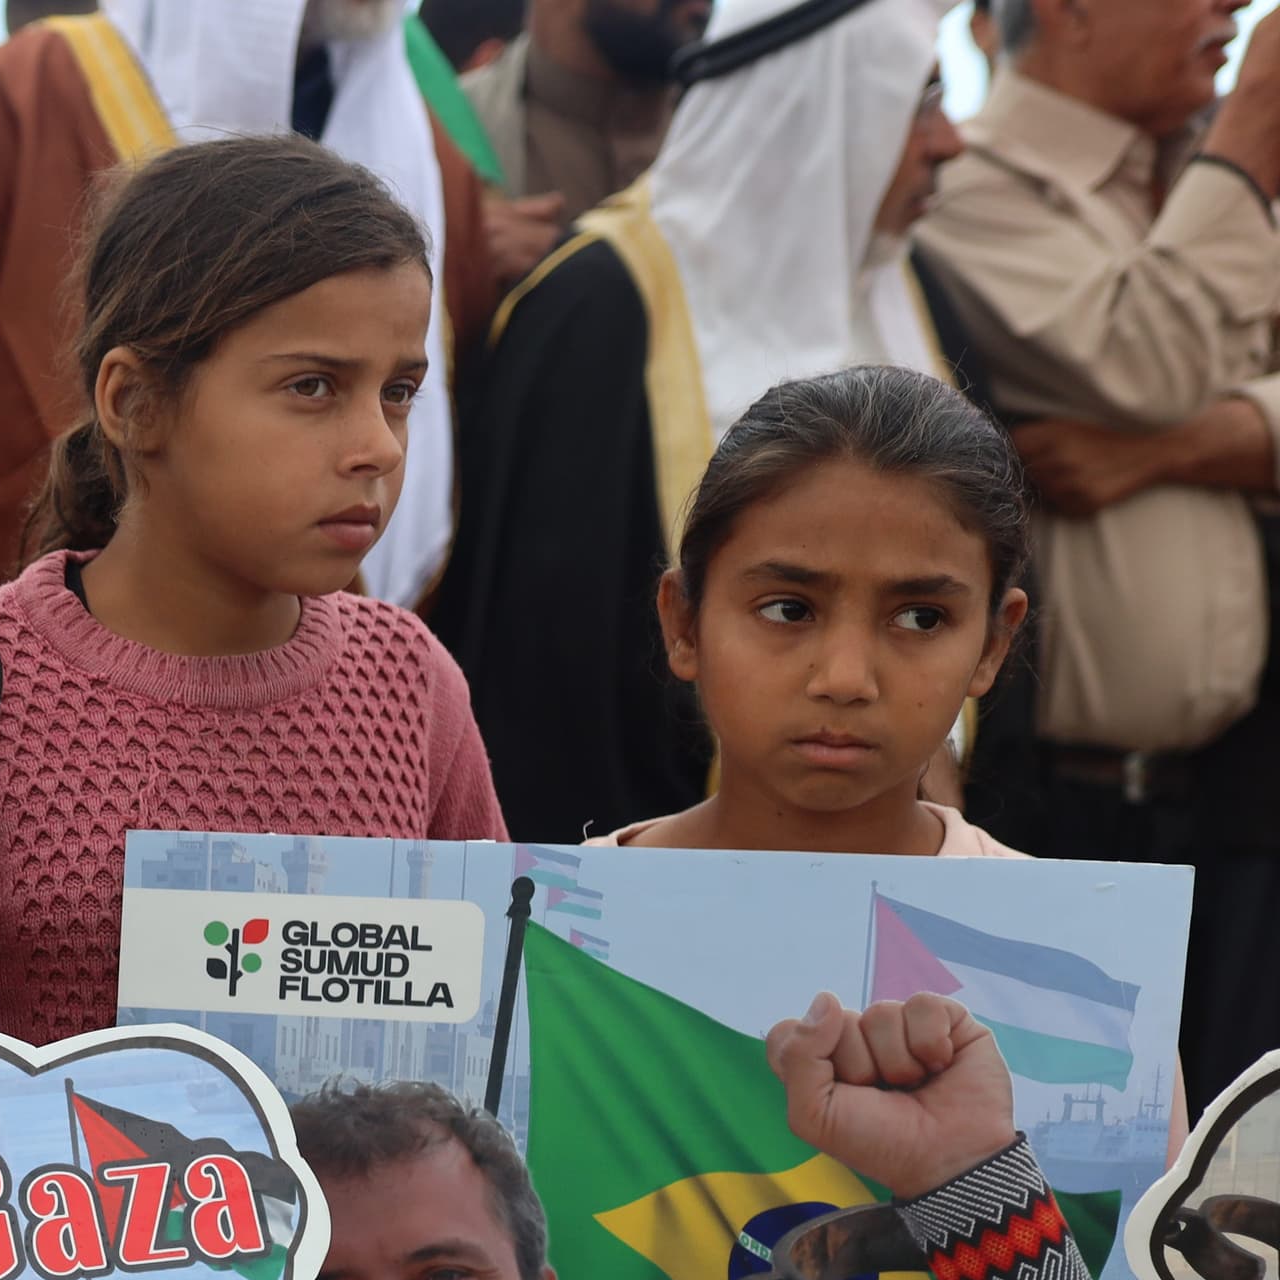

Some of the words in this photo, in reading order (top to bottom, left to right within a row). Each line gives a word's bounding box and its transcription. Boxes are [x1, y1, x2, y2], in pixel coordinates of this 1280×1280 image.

[281, 920, 433, 952] GLOBAL
[279, 949, 410, 978] SUMUD
[278, 975, 455, 1009] FLOTILLA
